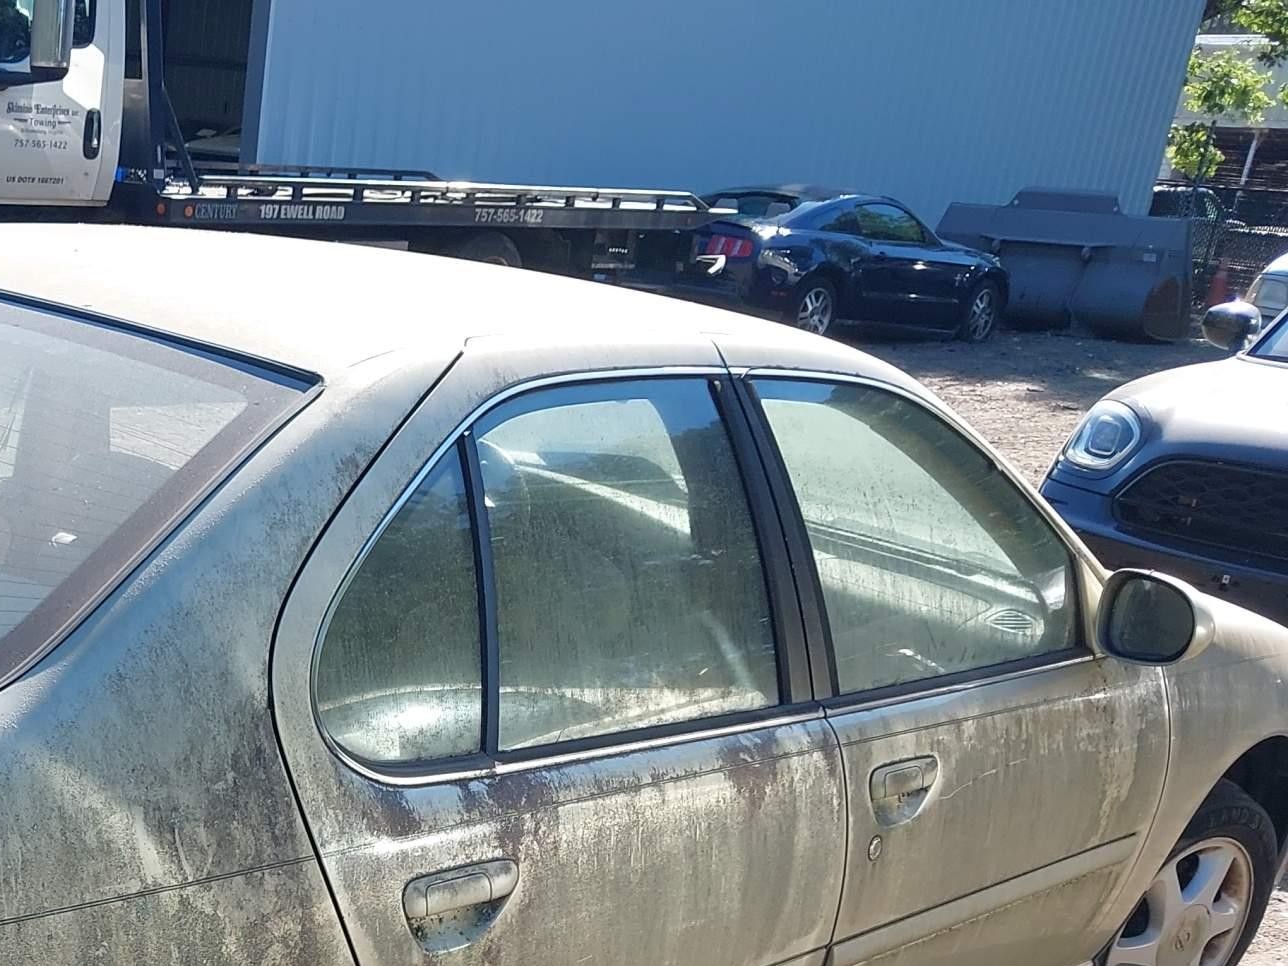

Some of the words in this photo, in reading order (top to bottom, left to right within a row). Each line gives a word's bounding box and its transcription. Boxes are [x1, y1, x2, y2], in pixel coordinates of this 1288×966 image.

[30, 118, 57, 129] Towing
[14, 140, 68, 149] 757-565-1422
[194, 203, 238, 219] CENTURY
[259, 205, 281, 219] 197
[280, 205, 313, 219] EWELL
[314, 206, 346, 220] ROAD
[474, 207, 544, 223] 757-565-1422
